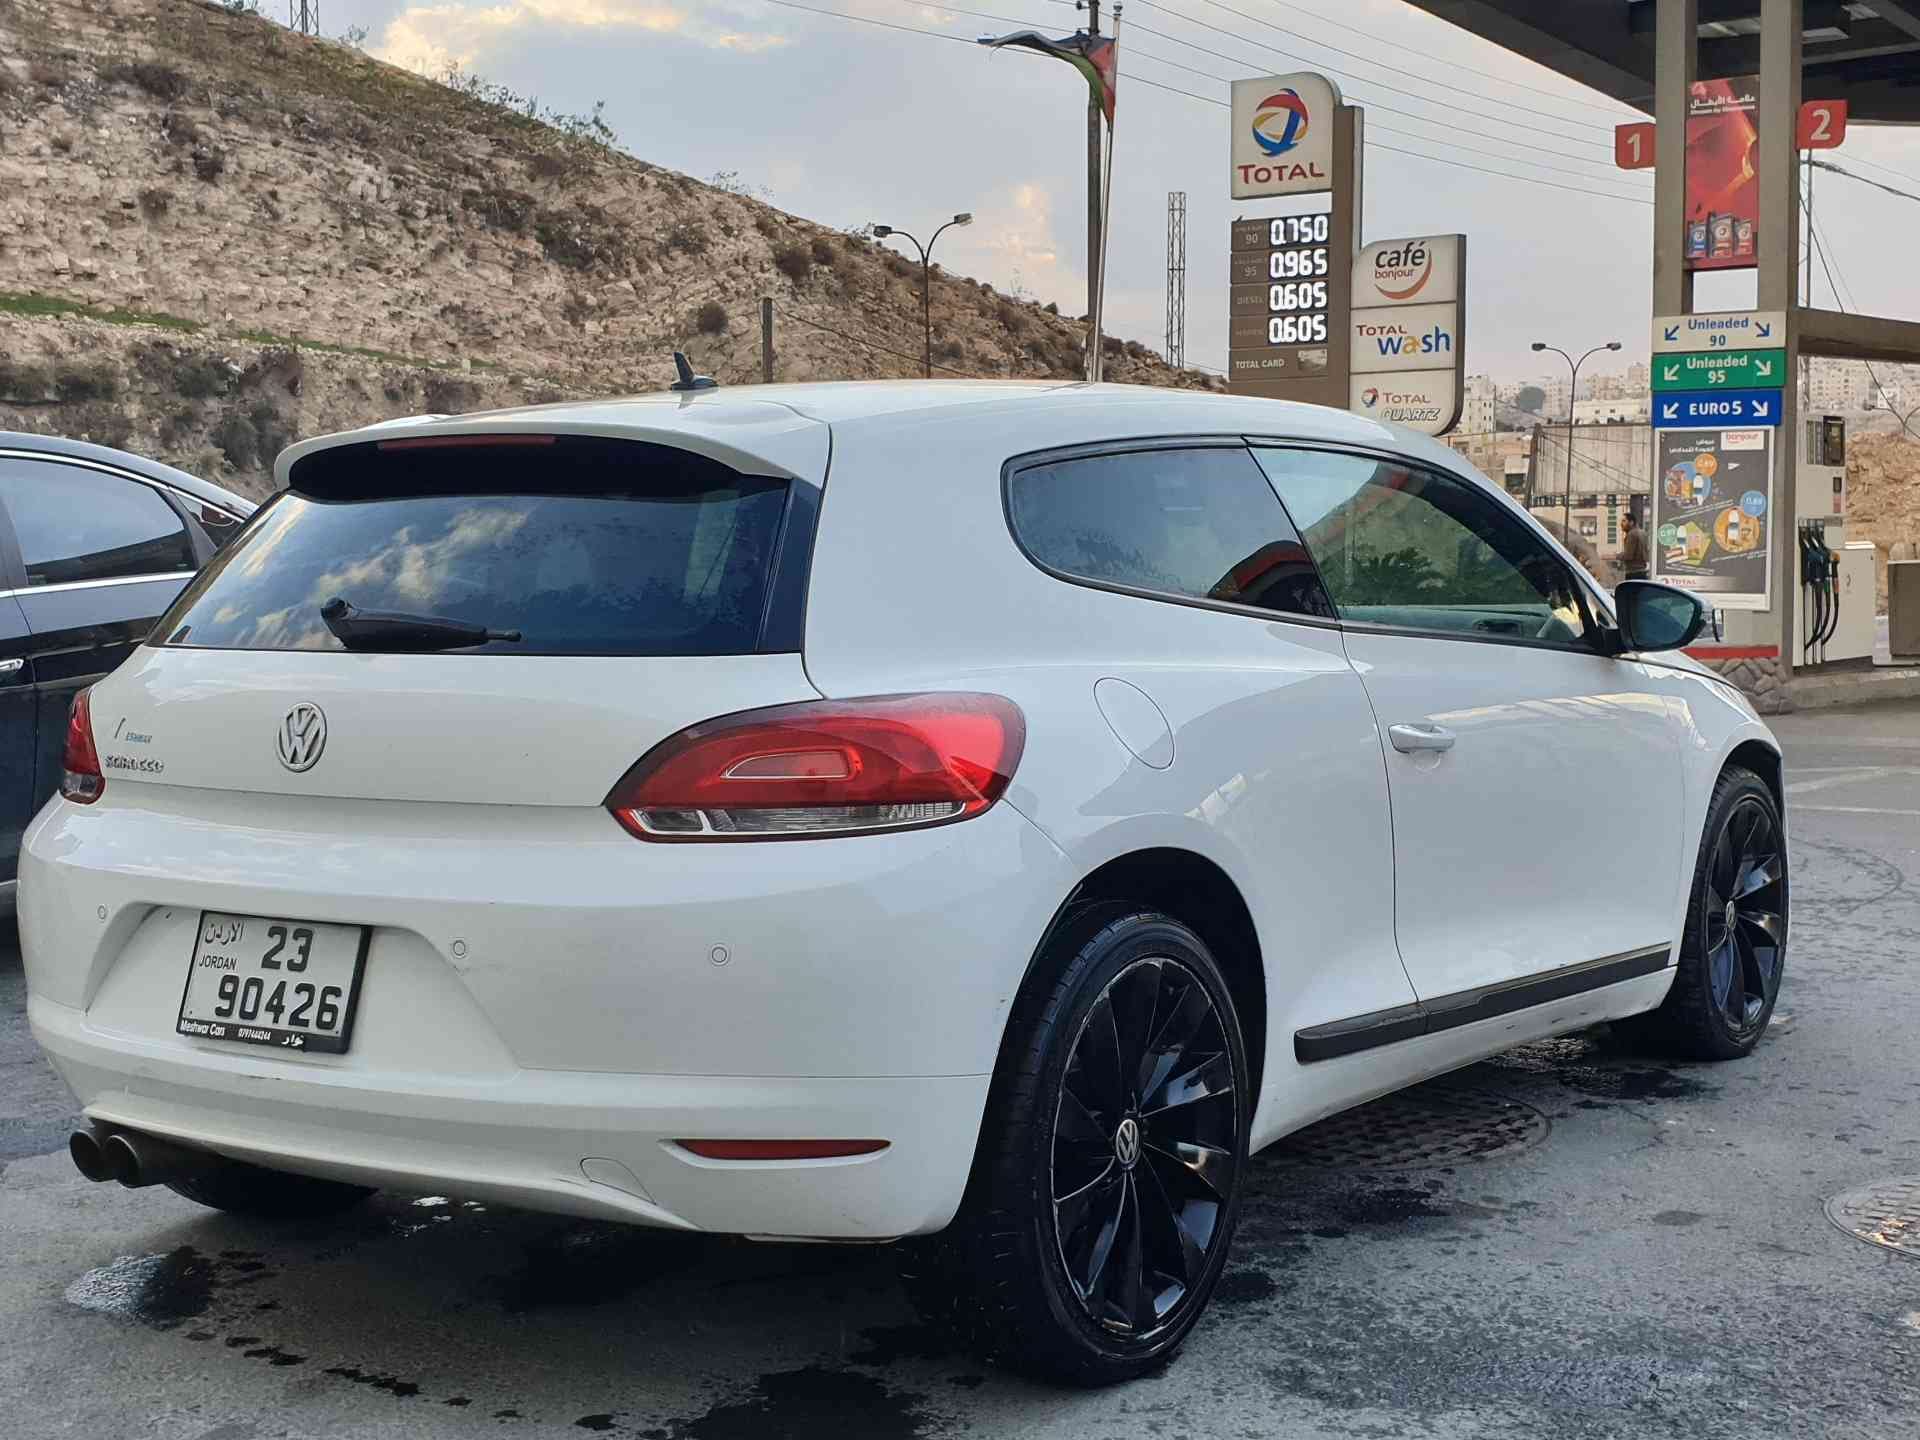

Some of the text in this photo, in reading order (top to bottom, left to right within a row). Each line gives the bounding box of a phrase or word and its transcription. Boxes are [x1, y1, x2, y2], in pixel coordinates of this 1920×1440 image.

[1810, 108, 1832, 141] 2
[1626, 132, 1641, 163] 1
[1237, 161, 1325, 184] TOTAL
[1245, 233, 1258, 245] 90
[1375, 241, 1426, 269] café
[1244, 265, 1257, 277] 95
[1375, 268, 1415, 281] bonjour
[1356, 324, 1408, 337] TOTAL
[1688, 317, 1749, 330] Unleaded
[1377, 325, 1450, 356] wash
[1709, 335, 1726, 346] 90
[1235, 359, 1260, 369] TOTAL
[1686, 355, 1748, 369] Unleaded
[1707, 370, 1726, 384] 95
[1383, 391, 1431, 405] TOTAL
[1382, 407, 1441, 422] QUARTZ
[261, 925, 314, 973] 23
[199, 953, 237, 972] JORDAN
[214, 974, 343, 1031] 90426
